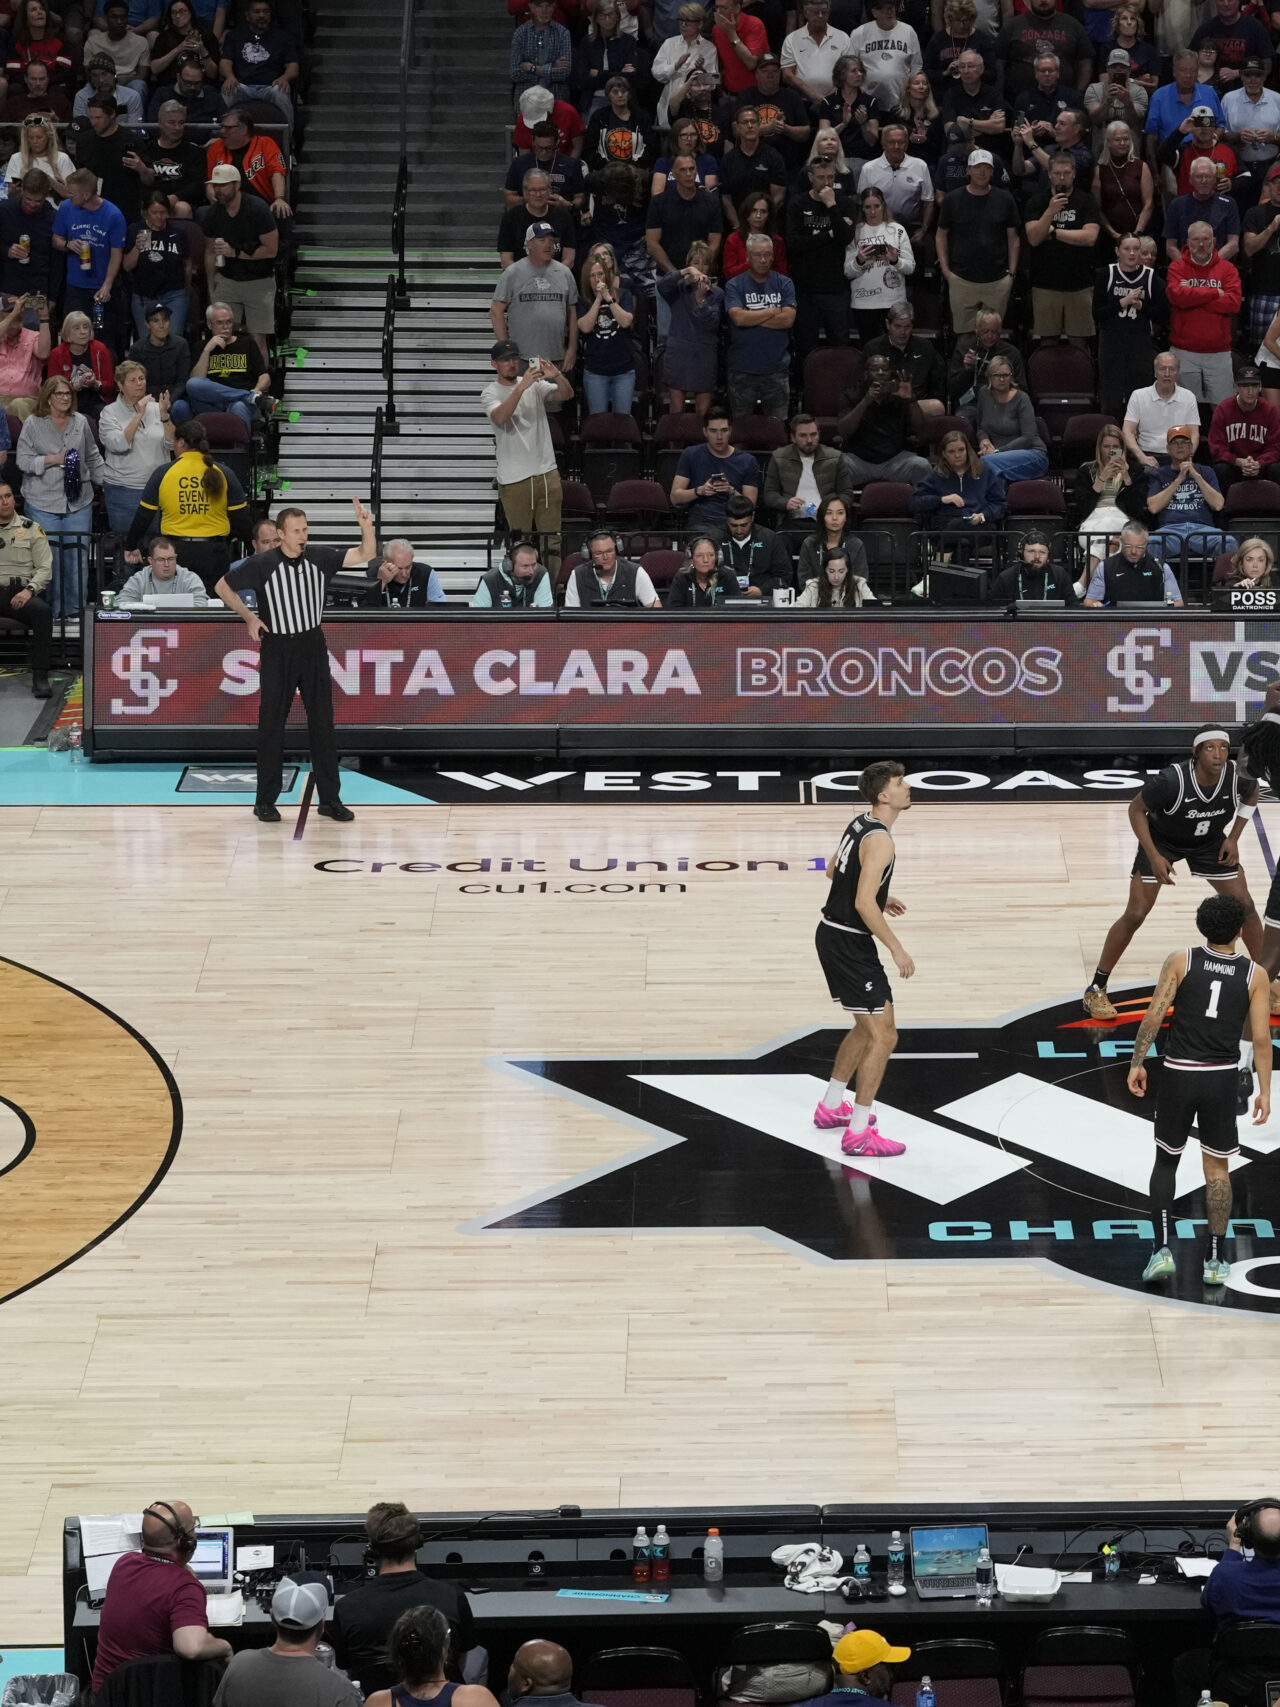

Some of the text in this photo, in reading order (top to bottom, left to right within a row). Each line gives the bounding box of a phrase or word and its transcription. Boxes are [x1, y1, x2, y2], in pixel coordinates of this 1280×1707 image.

[865, 41, 908, 54] GONZAGA
[154, 164, 184, 177] WCC
[518, 292, 563, 302] BASKETBALL
[179, 504, 210, 515] STAFF
[1231, 591, 1277, 606] POSS
[219, 647, 701, 696] SNTA CLARA
[736, 646, 1063, 696] BRONCOS
[1199, 650, 1280, 692] VS
[436, 770, 782, 792] WEST
[810, 769, 1160, 791] COAS
[1184, 806, 1227, 820] Broncos
[1193, 820, 1211, 837] 8
[313, 856, 827, 873] Credit Union 1
[458, 882, 687, 894] cu1.com
[1203, 964, 1237, 978] HAMMOND
[1204, 979, 1223, 1019] 1
[707, 1557, 717, 1568] G
